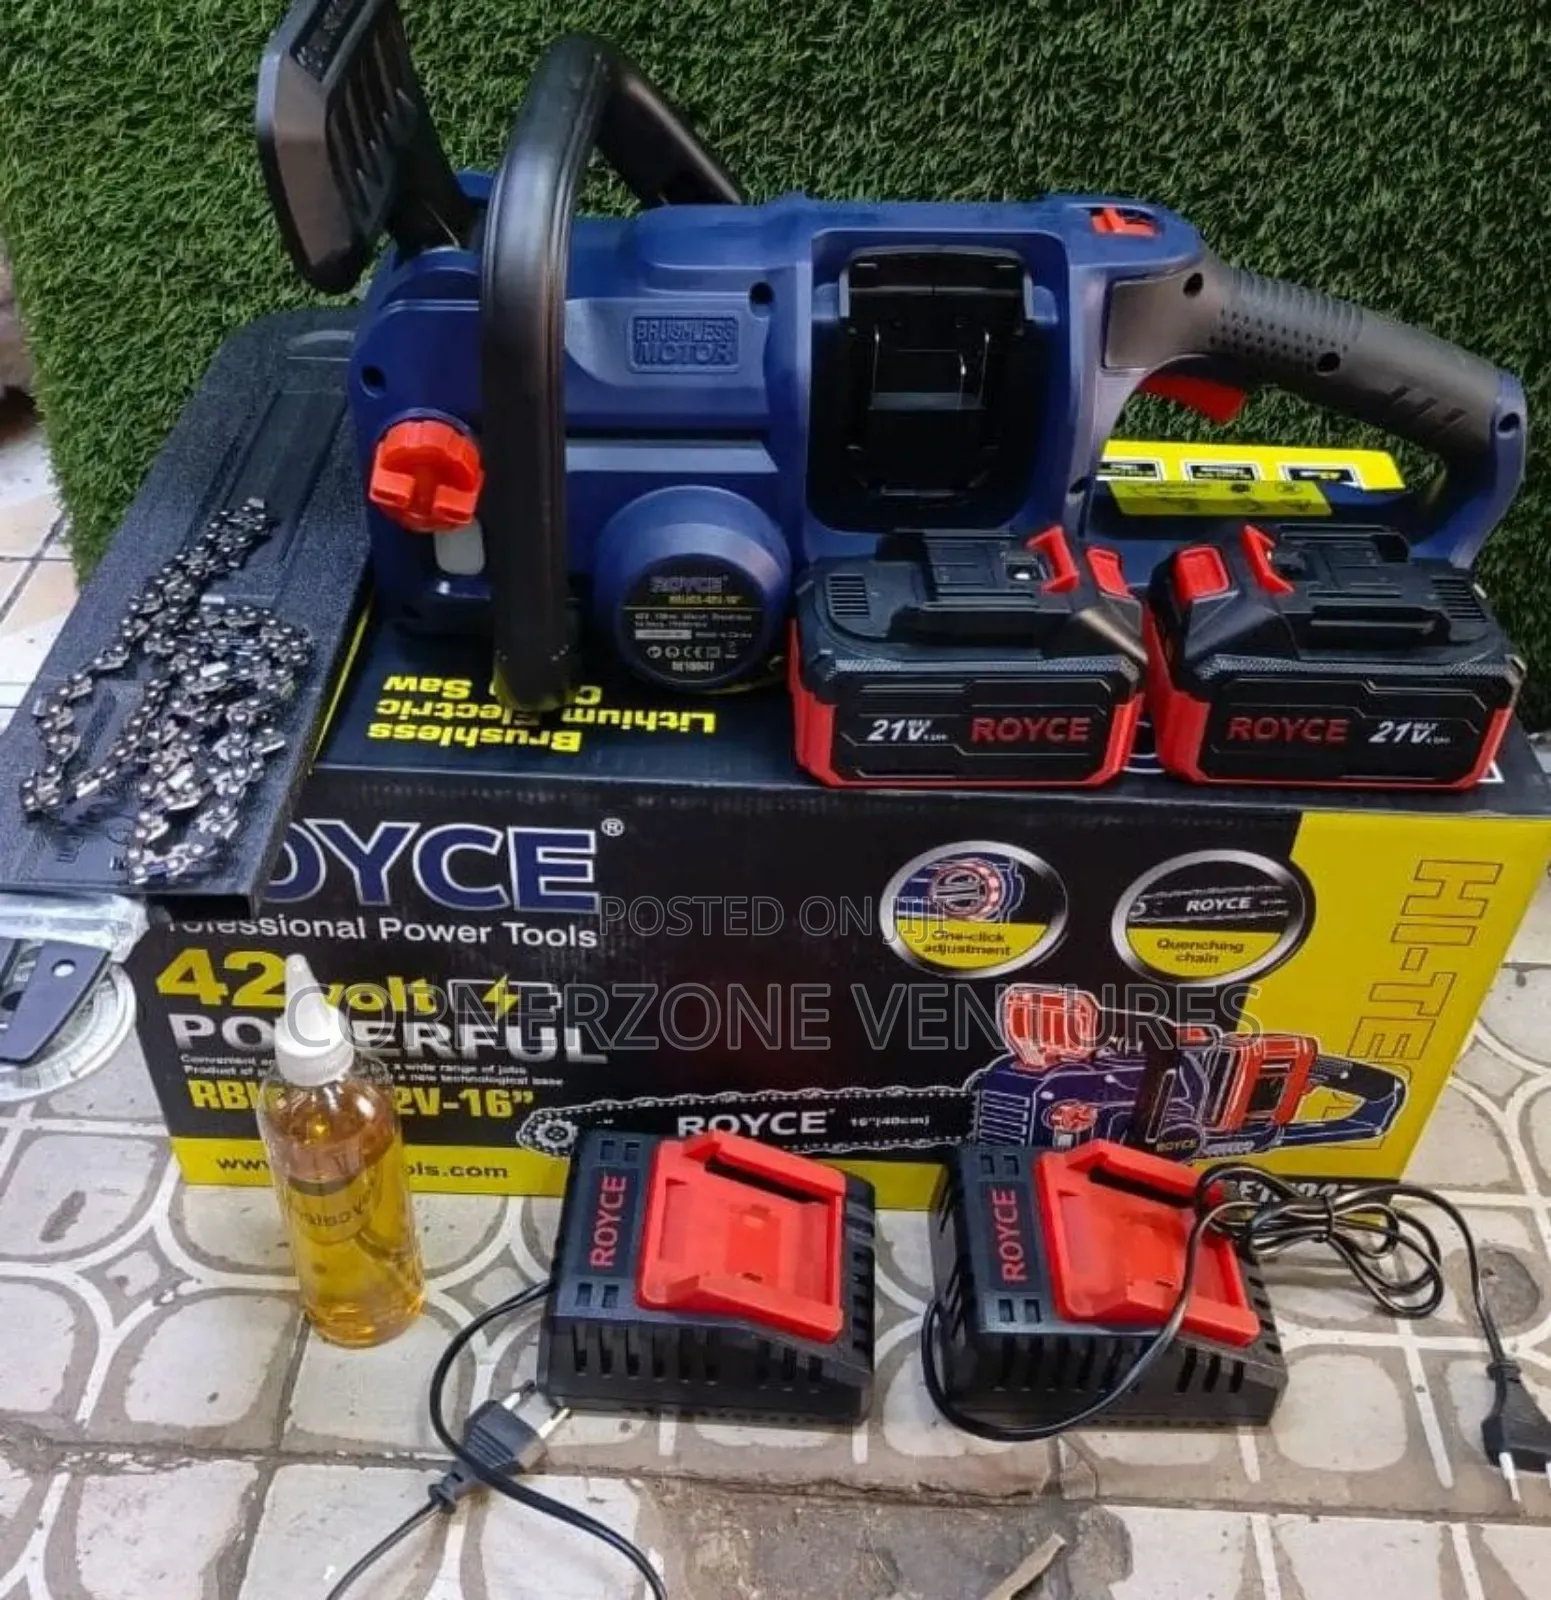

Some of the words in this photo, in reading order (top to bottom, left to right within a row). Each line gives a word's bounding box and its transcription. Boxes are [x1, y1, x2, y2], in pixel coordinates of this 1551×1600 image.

[383, 675, 473, 700] Saw
[561, 707, 716, 734] Lithium
[971, 716, 1092, 742] ROYCE
[1226, 715, 1351, 742] ROYCE
[367, 721, 583, 752] Brushless
[1186, 897, 1252, 912] ROYCE
[379, 916, 493, 945] Power
[499, 921, 599, 948] Tools
[930, 929, 1006, 944] One-click
[1156, 937, 1245, 954] Quenching
[923, 943, 1012, 957] adjustment
[1175, 951, 1220, 965] chain
[155, 947, 287, 1008] 42
[1338, 859, 1504, 1100] HI-TE
[168, 1013, 608, 1064] POERFUL
[677, 1109, 828, 1137] ROYCE
[589, 1174, 627, 1268] ROYCE
[991, 1188, 1029, 1282] ROYCE
